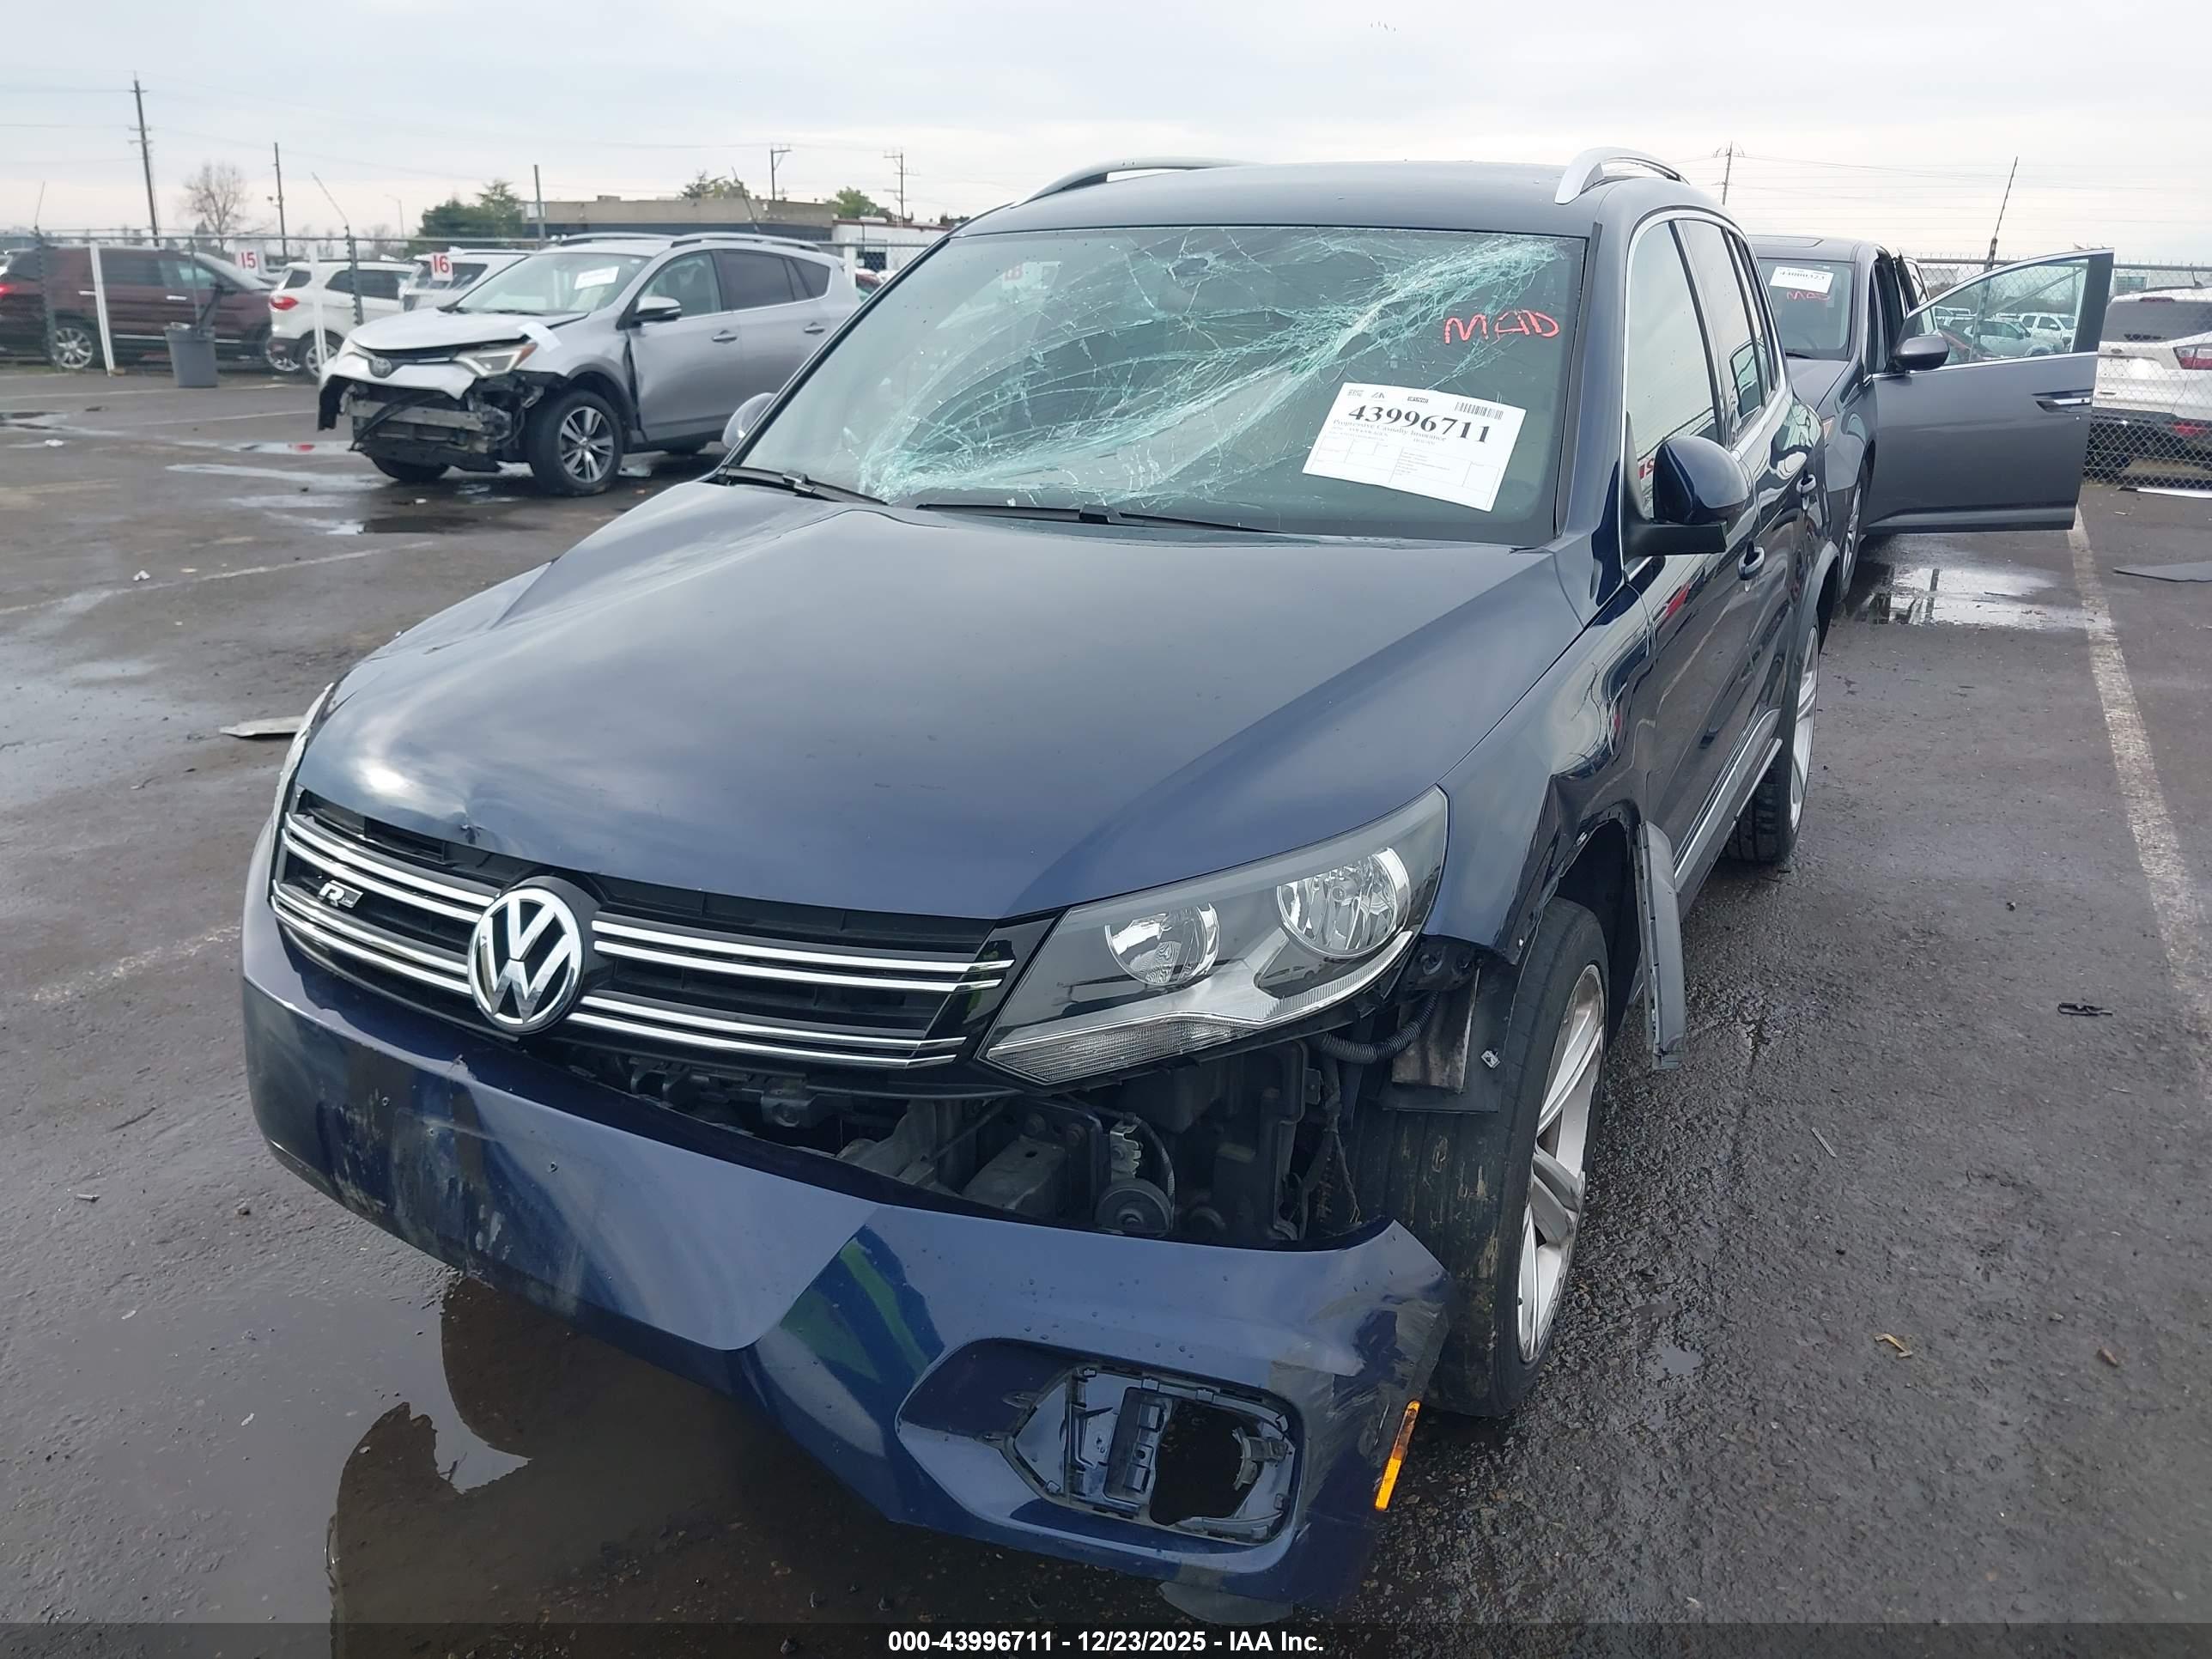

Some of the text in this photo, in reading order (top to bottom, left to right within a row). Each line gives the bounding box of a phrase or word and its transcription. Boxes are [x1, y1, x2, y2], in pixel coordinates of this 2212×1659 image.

[240, 252, 256, 269] 15
[433, 255, 449, 273] 16
[1443, 308, 1560, 344] MAD
[1348, 404, 1490, 443] 43996711
[471, 890, 580, 1024] VW
